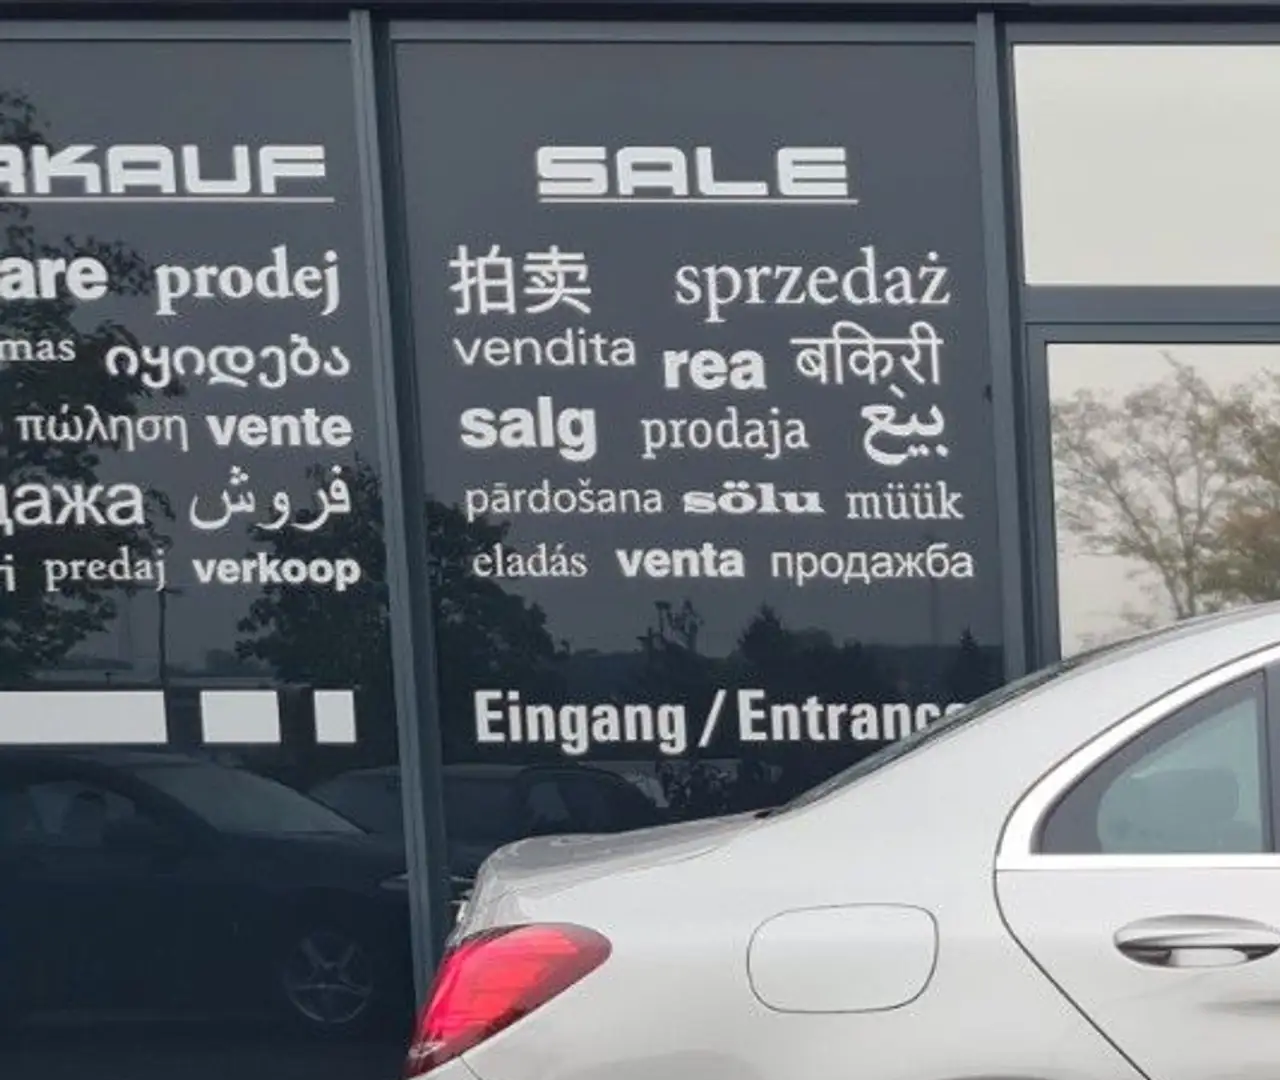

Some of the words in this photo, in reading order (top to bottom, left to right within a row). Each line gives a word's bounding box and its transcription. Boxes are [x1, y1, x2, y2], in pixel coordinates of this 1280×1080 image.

[537, 146, 848, 195] SALE
[156, 245, 339, 315] prodej
[450, 245, 591, 314] 拍卖
[676, 246, 950, 323] sprzedaż
[107, 334, 349, 388] იყიდება
[454, 328, 635, 366] vendita
[664, 350, 766, 389] rea
[16, 404, 189, 452] πώληση
[206, 408, 352, 447] vente
[461, 396, 596, 461] salg
[641, 407, 809, 459] prodaja
[190, 465, 350, 530] فروش
[466, 479, 662, 522] pārdošana
[683, 481, 824, 513] sölu
[846, 481, 963, 519] müük
[44, 546, 166, 592] predaj
[192, 552, 360, 591] verkoop
[474, 543, 587, 576] eladás
[616, 543, 744, 577] venta
[772, 543, 973, 586] продажба
[475, 691, 686, 754] Eingang
[738, 690, 966, 742] Entranc
